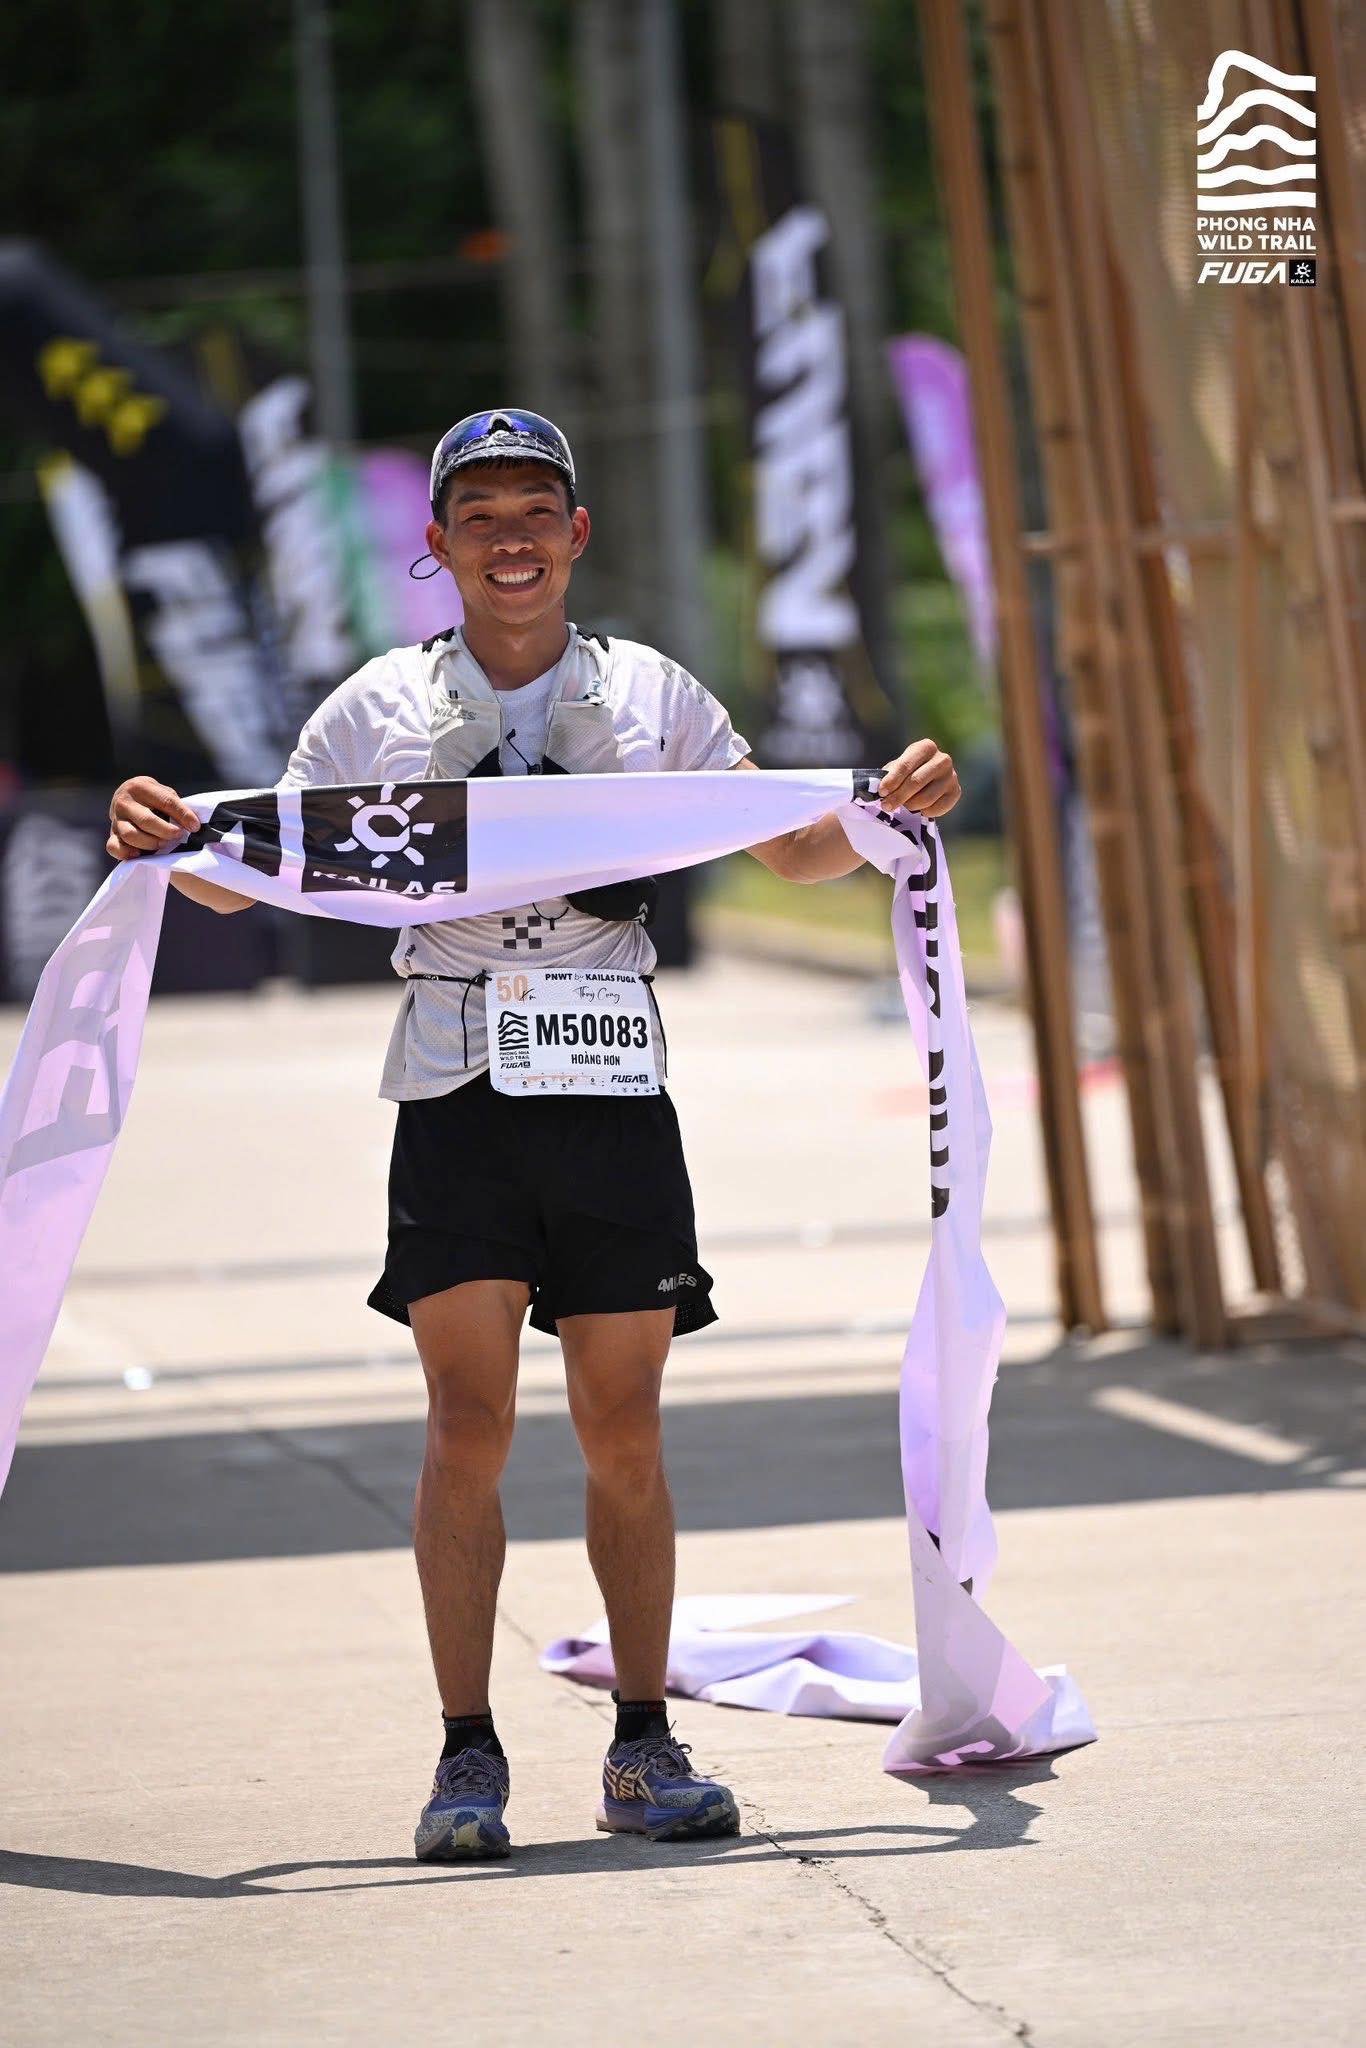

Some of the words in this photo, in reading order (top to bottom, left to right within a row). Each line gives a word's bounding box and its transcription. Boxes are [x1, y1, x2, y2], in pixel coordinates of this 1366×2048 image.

[545, 973, 573, 982] PNWT
[585, 973, 615, 982] KAILAS
[616, 975, 637, 984] FUGA
[495, 975, 529, 1003] 50
[535, 1013, 649, 1049] M50083
[571, 1051, 602, 1065] HOÀNG
[500, 1061, 524, 1069] FUGA
[610, 1074, 639, 1083] FUGA
